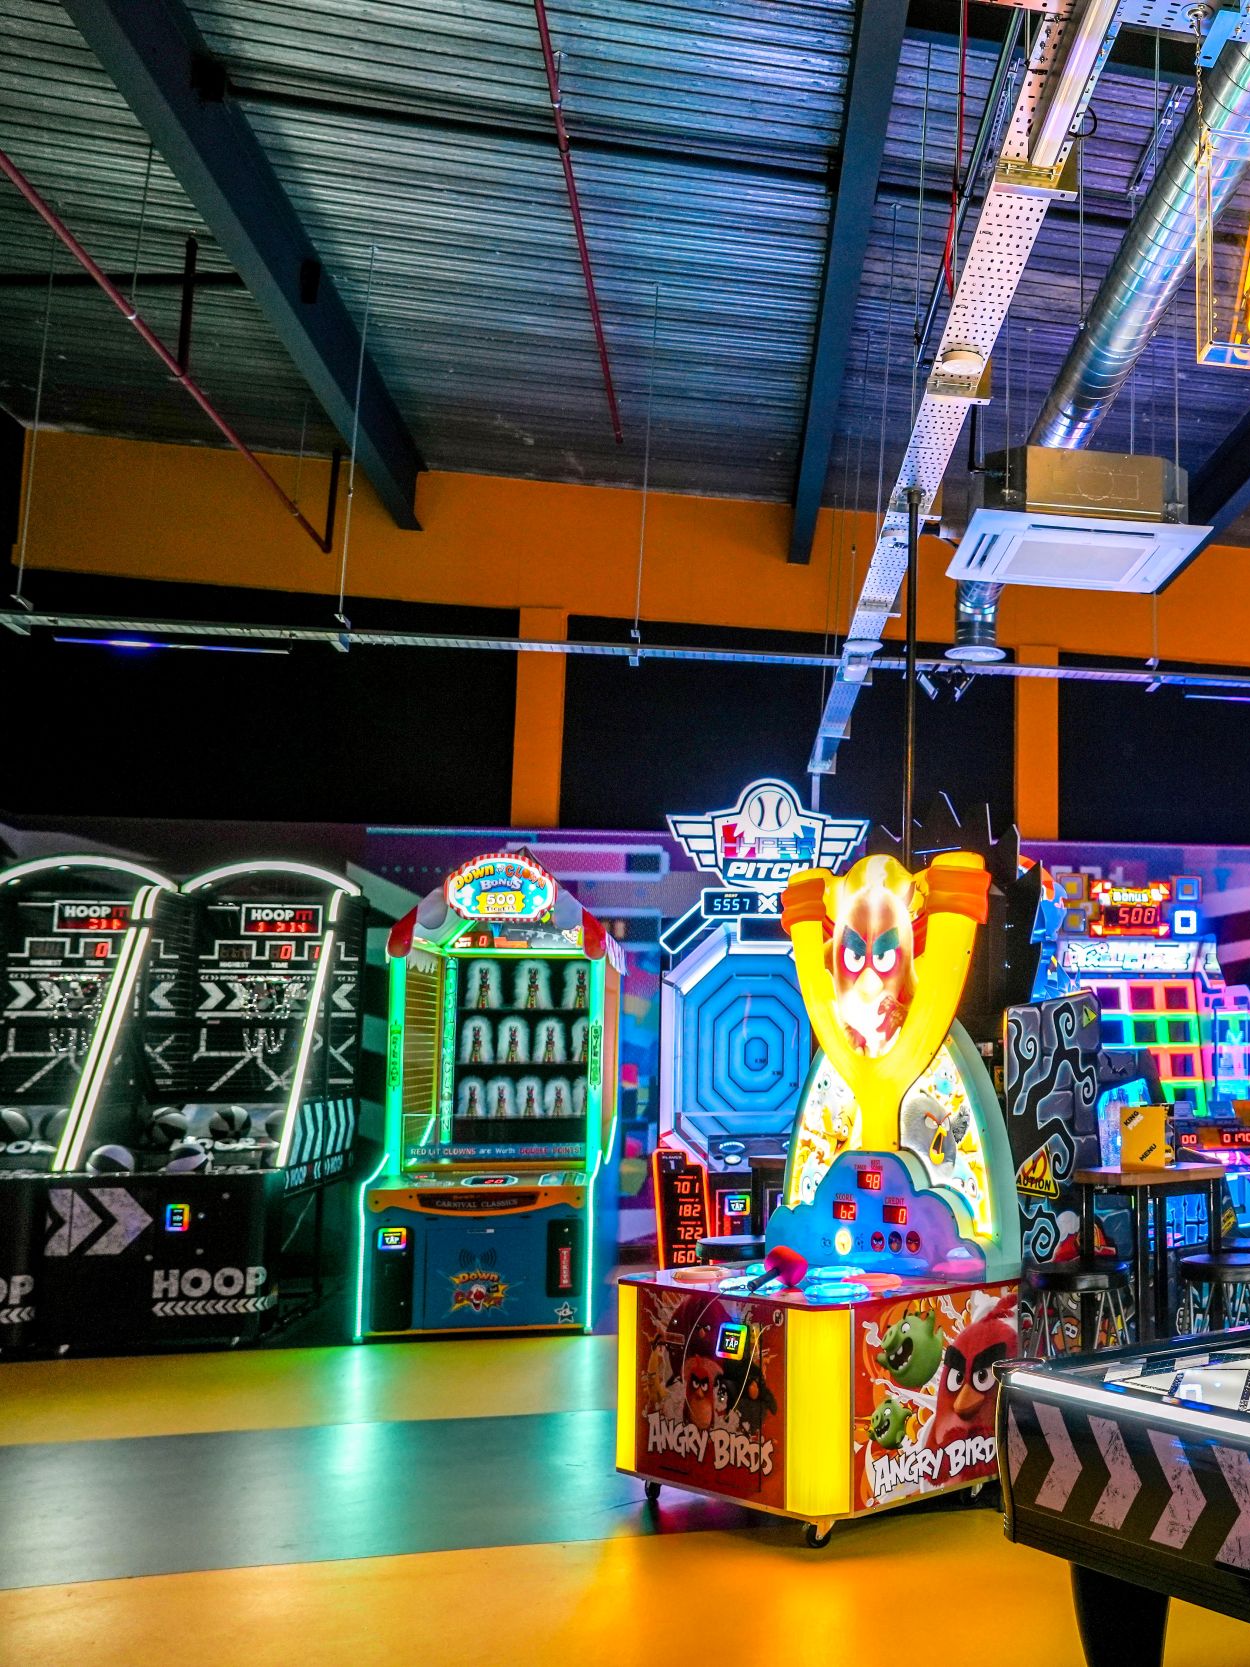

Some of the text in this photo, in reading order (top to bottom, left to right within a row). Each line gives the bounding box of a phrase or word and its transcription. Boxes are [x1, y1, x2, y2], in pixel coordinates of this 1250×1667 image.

[721, 836, 816, 855] HYPER
[480, 877, 523, 890] BONUS
[486, 894, 516, 905] 500
[713, 898, 750, 911] 5557
[63, 905, 112, 918] HOOP
[250, 908, 295, 921] HOOP
[1118, 907, 1156, 925] 500
[95, 942, 110, 958] 0
[279, 945, 293, 960] 0
[1123, 1110, 1140, 1127] KING
[1181, 1134, 1197, 1145] 00
[410, 1147, 428, 1156] RED
[442, 1147, 476, 1156] CLOWNS
[495, 1147, 516, 1155] Worth
[1139, 1143, 1157, 1162] MENU
[673, 1181, 700, 1194] 701
[865, 1173, 881, 1190] 98
[1016, 1174, 1052, 1191] AUTION
[435, 1199, 478, 1209] CARNIVAL
[678, 1204, 701, 1217] 182
[840, 1204, 856, 1220] 62
[898, 1208, 907, 1224] 0
[677, 1227, 703, 1240] 722
[152, 1266, 268, 1299] HOOP
[724, 1337, 739, 1349] TAP
[647, 1411, 774, 1476] ANGRY BIRDS
[873, 1435, 997, 1498] ANGRY BIRD
